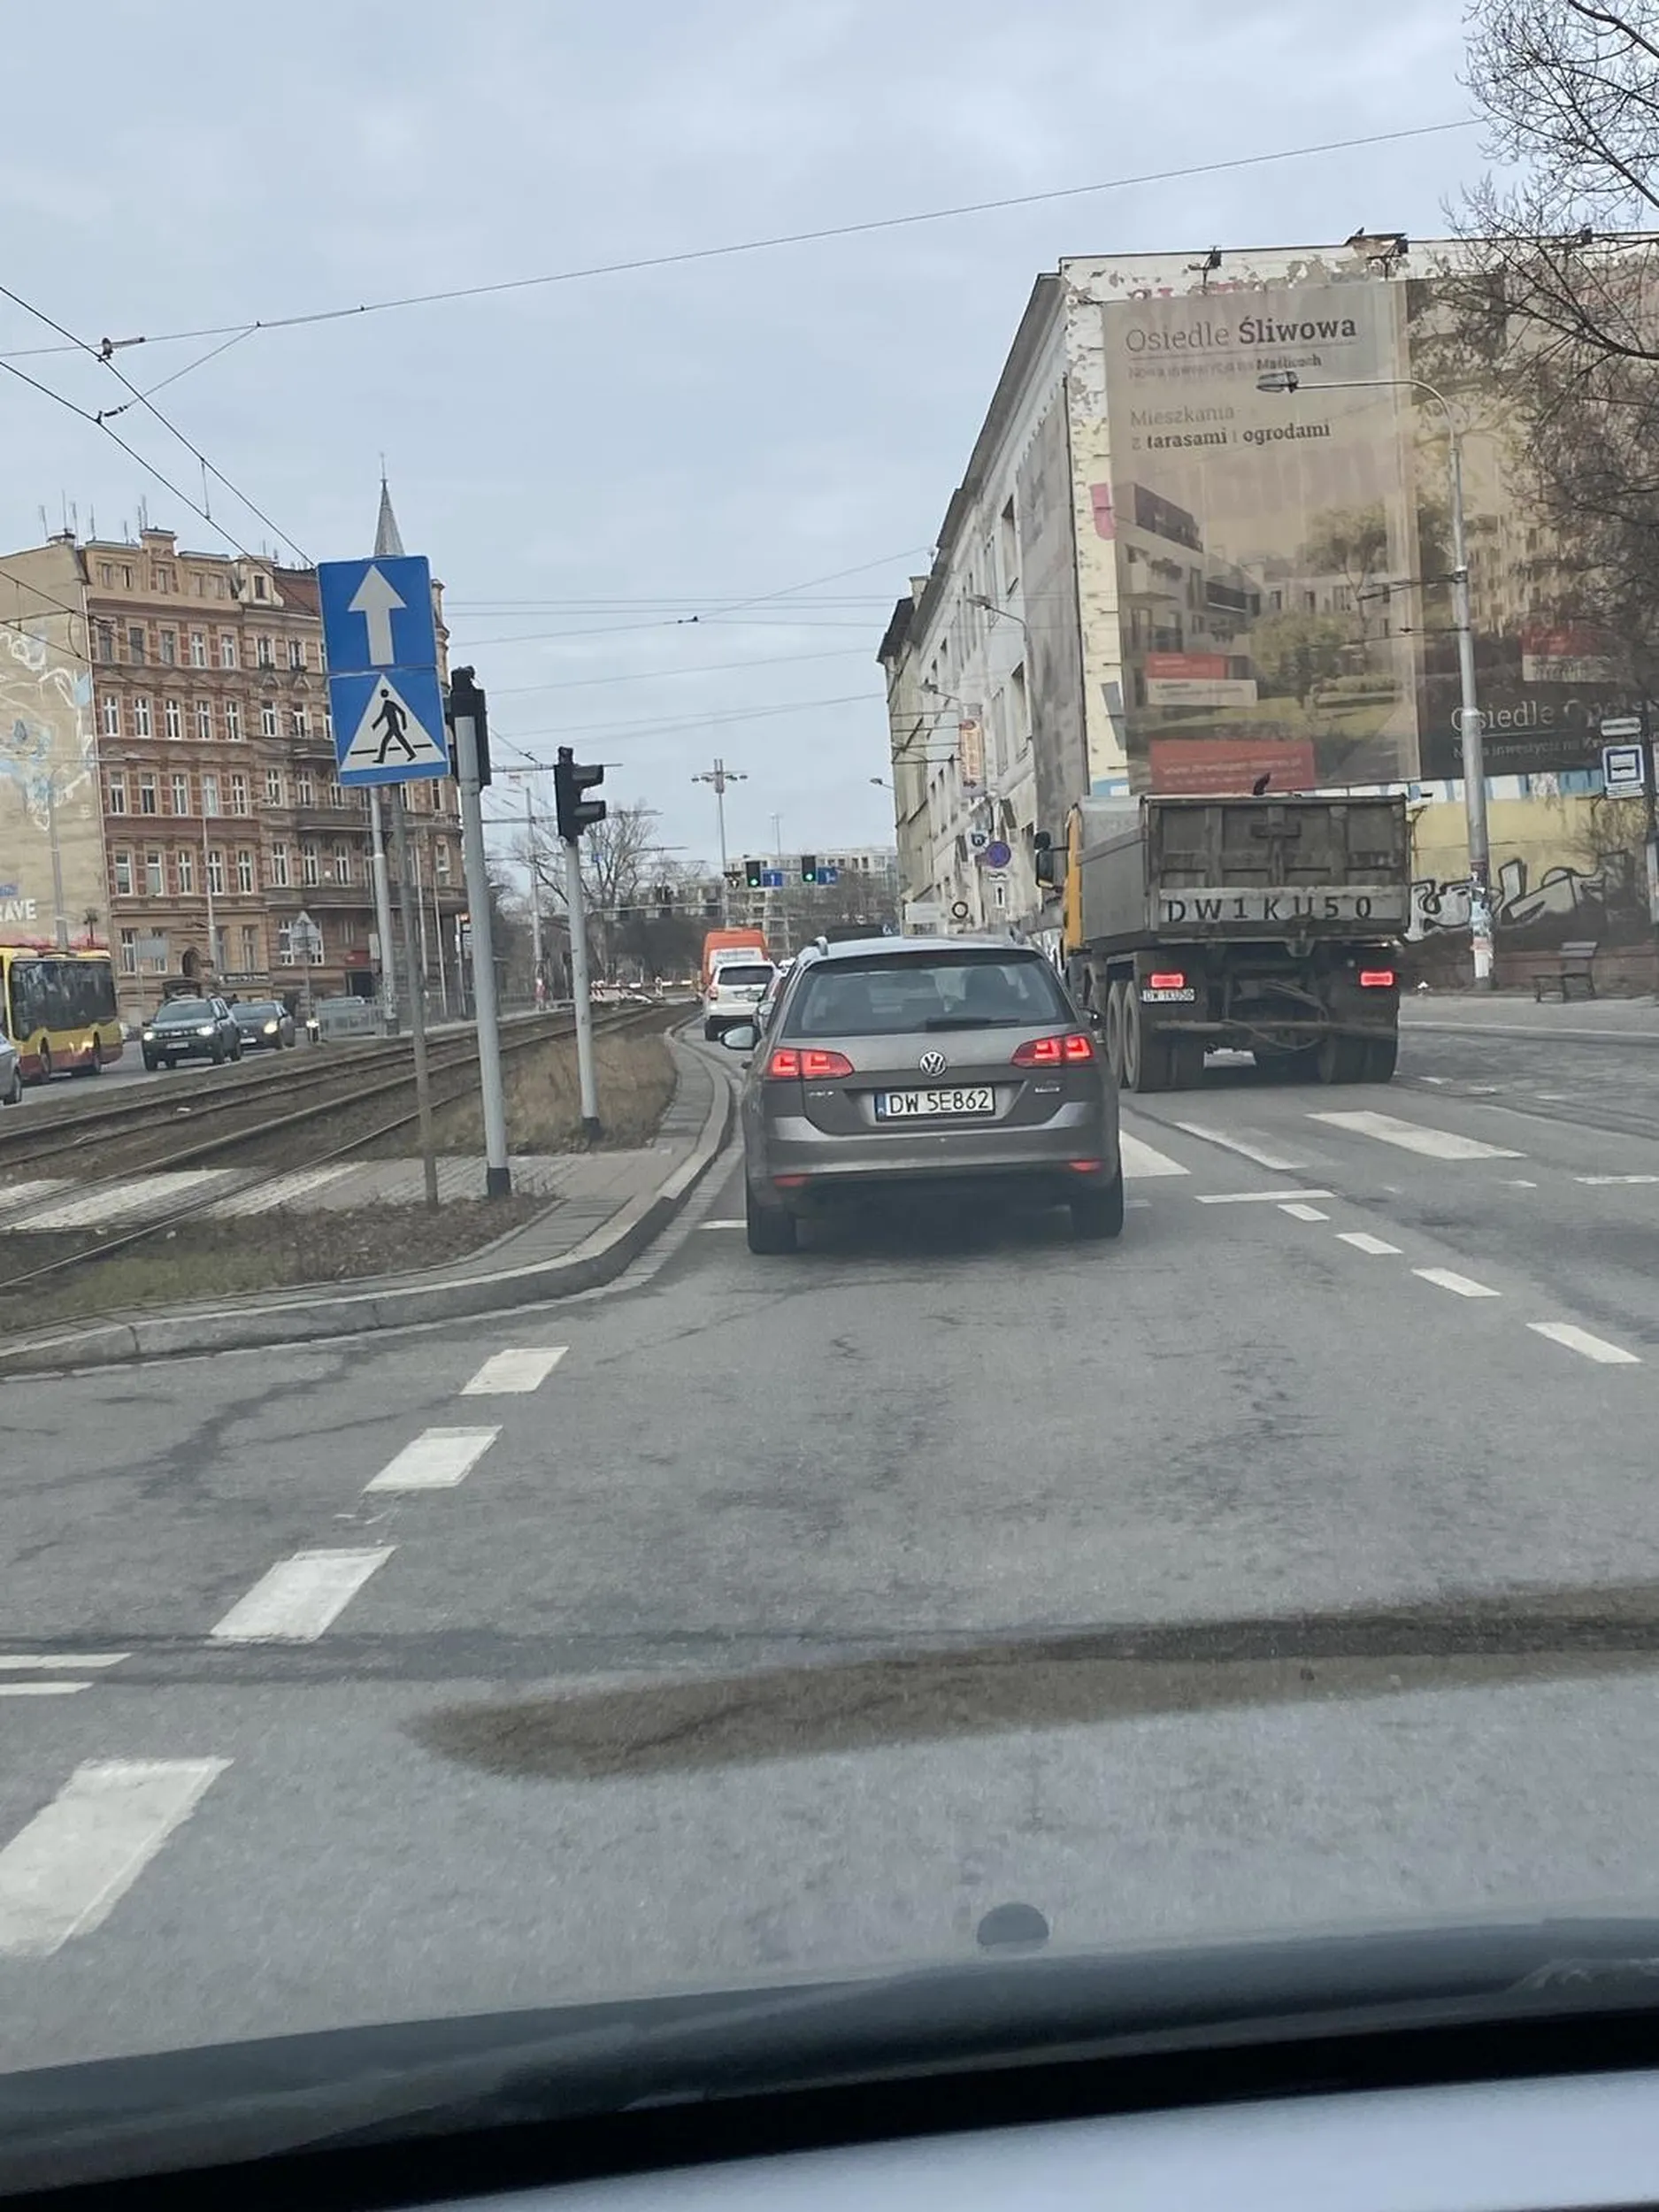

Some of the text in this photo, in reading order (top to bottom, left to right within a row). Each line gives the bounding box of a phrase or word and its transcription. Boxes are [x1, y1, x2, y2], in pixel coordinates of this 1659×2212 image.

[1125, 316, 1357, 352] Osiedle Śliwowa
[1147, 428, 1228, 449] tarasami
[1242, 421, 1332, 447] ogrodami
[889, 1089, 990, 1114] DW 5E862
